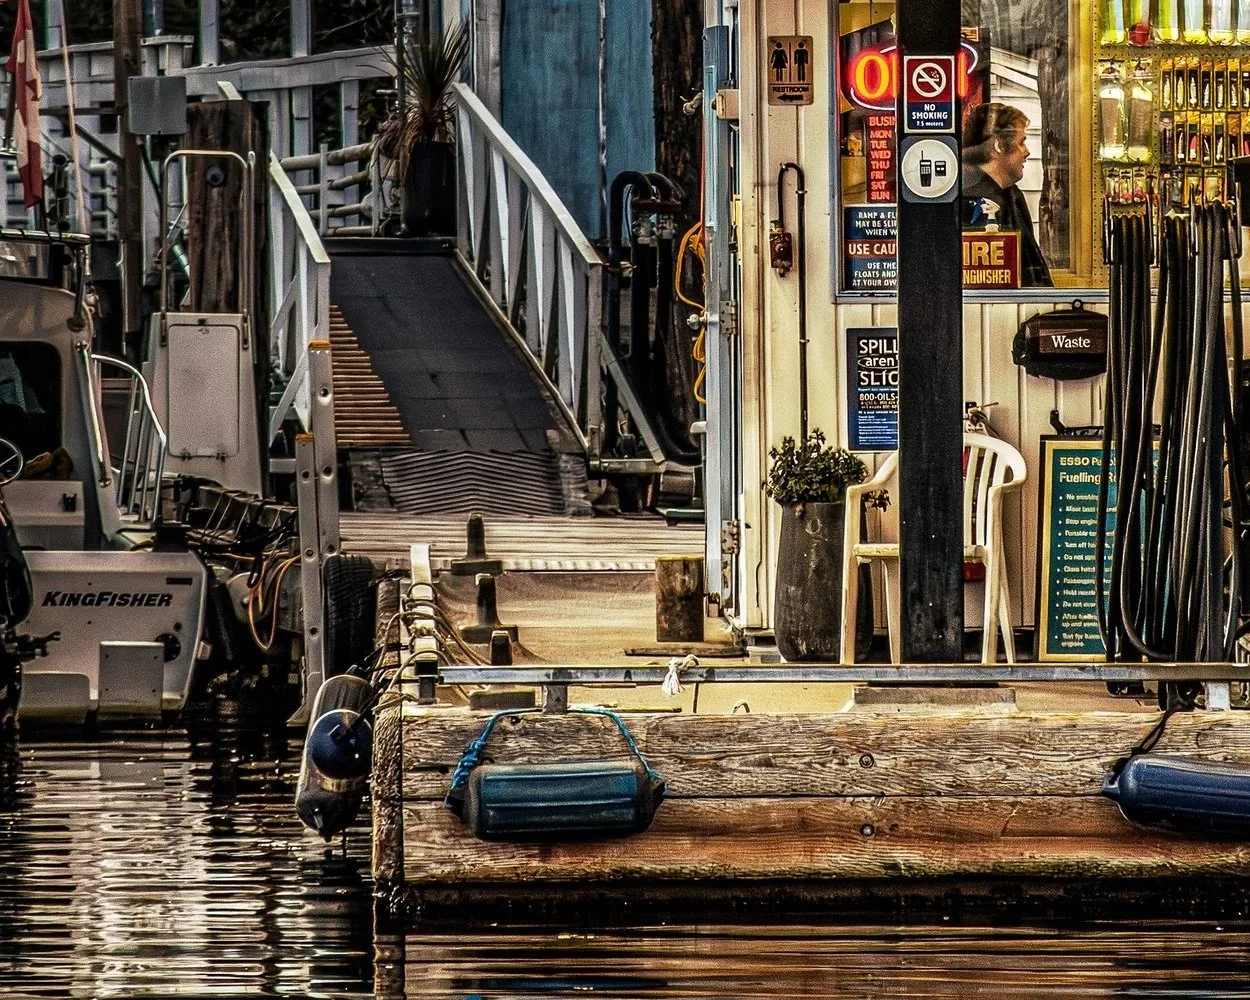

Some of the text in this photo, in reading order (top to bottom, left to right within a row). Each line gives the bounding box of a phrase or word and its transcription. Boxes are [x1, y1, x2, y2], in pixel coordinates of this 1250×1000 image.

[924, 103, 936, 111] NO
[911, 111, 948, 120] SMOKING
[870, 130, 892, 138] MON
[870, 140, 888, 149] TUE
[871, 150, 891, 159] WED
[871, 160, 890, 169] THU
[871, 170, 884, 179] FRI
[871, 181, 887, 190] SAT
[871, 191, 890, 200] SUN
[856, 220, 870, 228] MAY
[848, 243, 896, 255] USE CAU
[963, 241, 1004, 266] IRE
[867, 262, 880, 270] USE
[854, 270, 897, 278] FLOATS AND
[963, 269, 1011, 284] NGUISHER
[859, 339, 898, 354] SPILL
[1051, 335, 1091, 349] Waste
[865, 355, 899, 367] aren'
[860, 370, 898, 386] SLIC
[859, 392, 899, 401] 800-OILS-
[1060, 456, 1090, 466] ESSO
[1059, 472, 1101, 485] Fuelling
